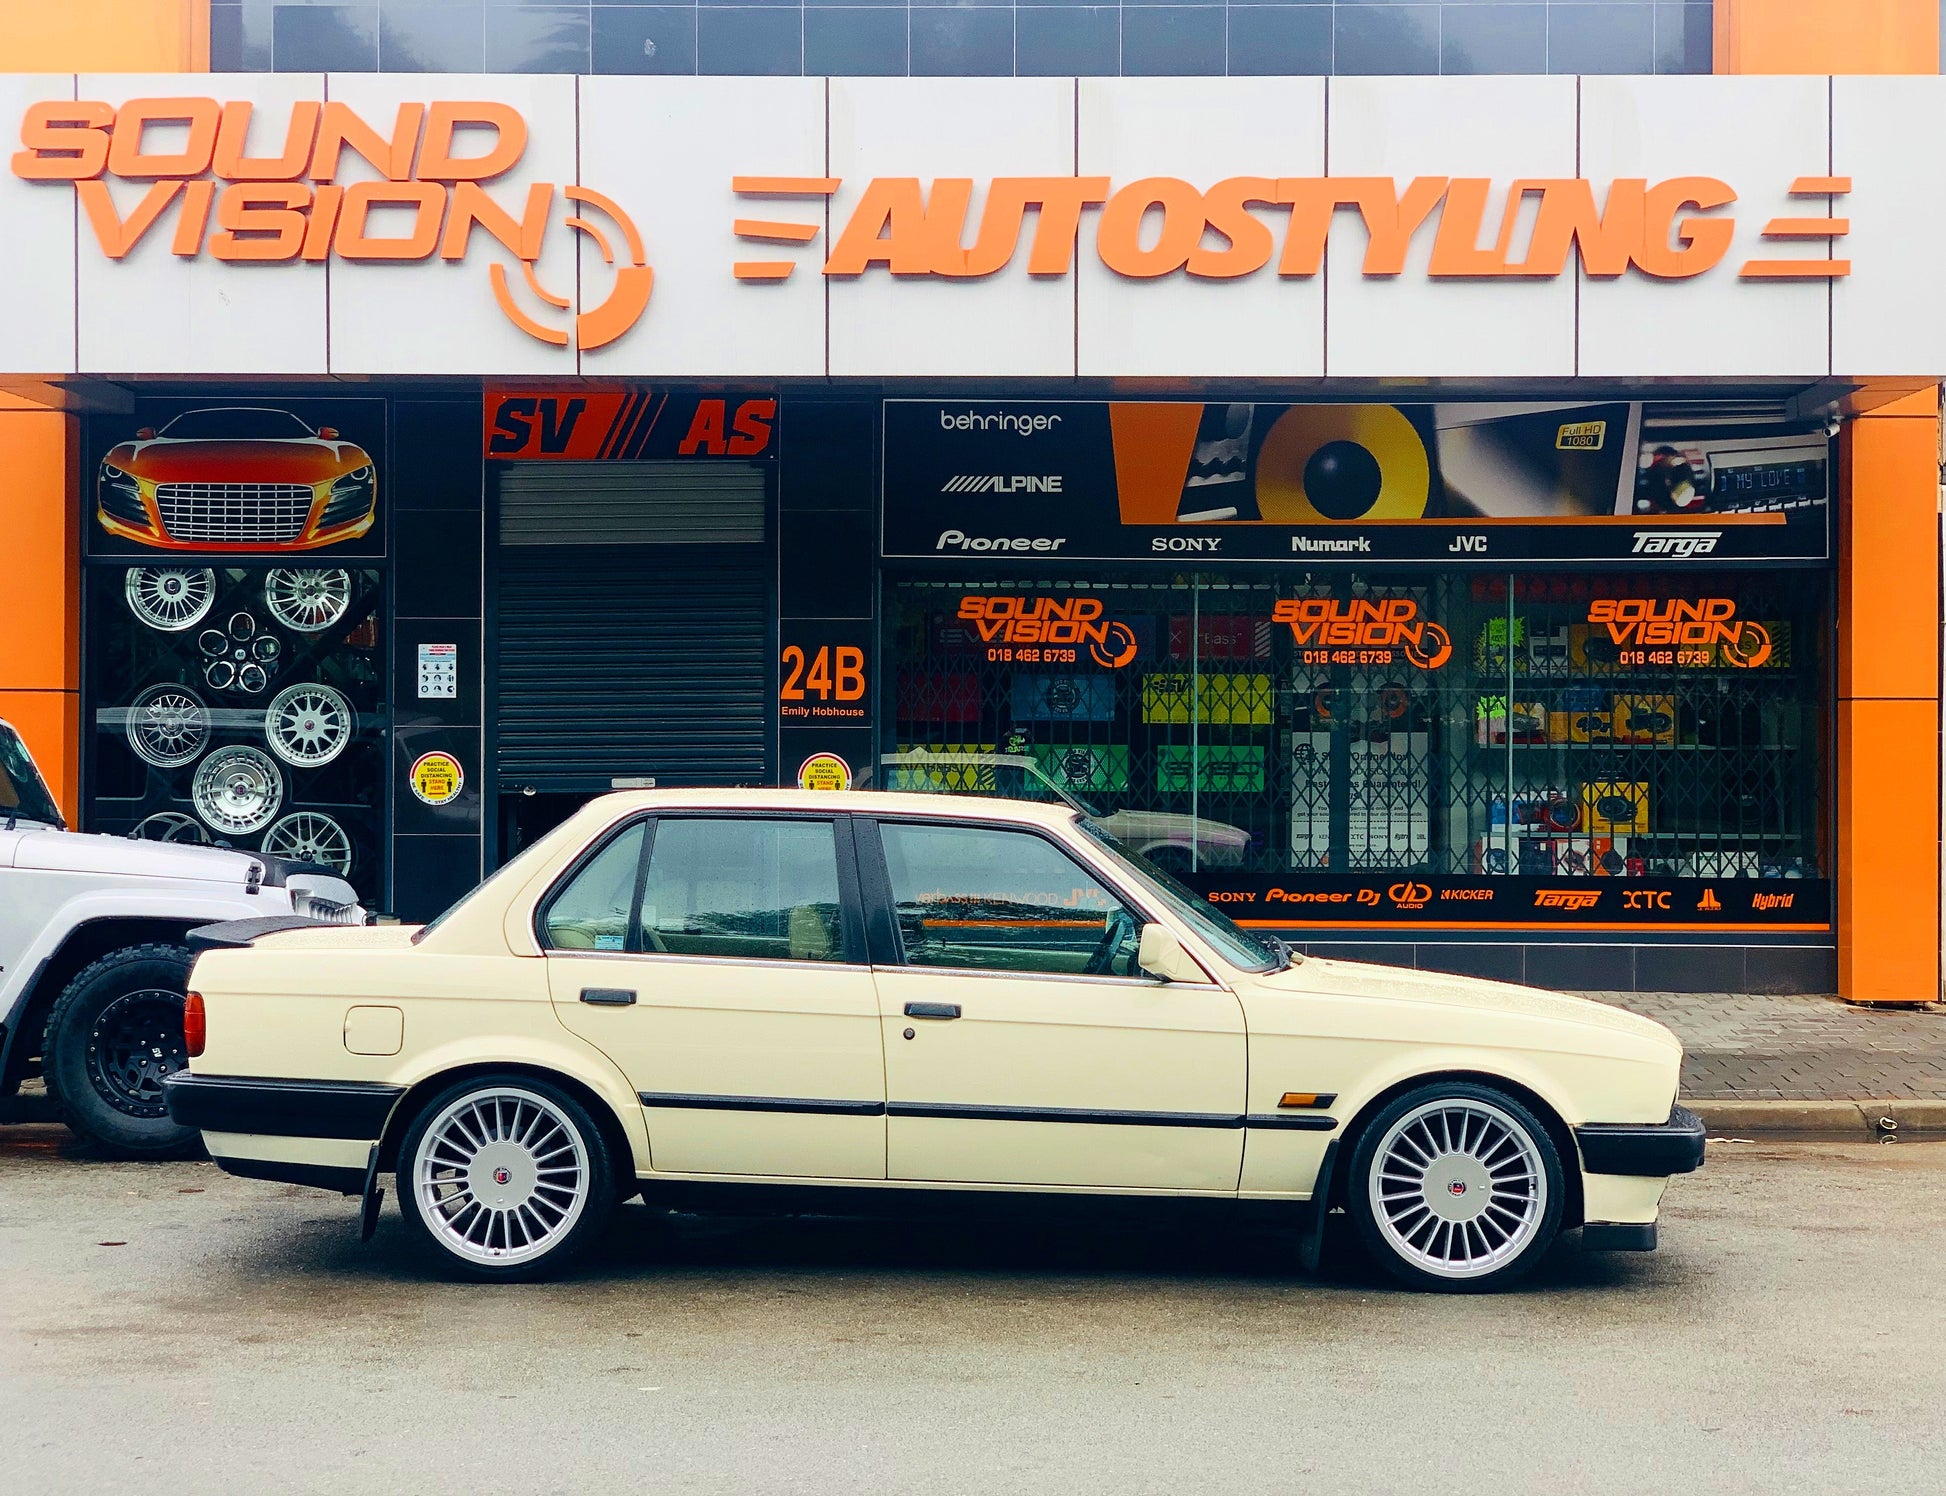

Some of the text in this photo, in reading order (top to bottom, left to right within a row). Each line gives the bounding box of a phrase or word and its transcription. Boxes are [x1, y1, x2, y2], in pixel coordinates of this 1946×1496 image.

[11, 97, 528, 181] SOUND
[74, 180, 555, 261] VISION
[822, 176, 1737, 279] AUTOSTYLING
[489, 398, 587, 454] SV
[678, 400, 778, 455] AS
[941, 410, 1062, 436] behringer
[1562, 424, 1602, 435] Full HD
[1567, 436, 1593, 446] 1080
[936, 530, 1066, 551] Pioneer
[1152, 538, 1222, 551] SONY
[1292, 536, 1371, 552] Numark
[1449, 536, 1487, 552] JVC
[1632, 532, 1723, 558] Targa
[957, 596, 1104, 621] SOUND
[1272, 599, 1417, 623] SOUND
[1587, 599, 1736, 622] SOUND
[976, 619, 1110, 644] VISION
[1290, 622, 1424, 645] VISION
[1606, 621, 1743, 645] VISION
[987, 648, 1076, 662] 018 462 6739
[1303, 650, 1329, 664] 018
[1331, 650, 1356, 664] 462
[1359, 650, 1392, 664] 6739
[1620, 651, 1710, 664] 018 462 6739
[781, 645, 866, 700] 24B
[781, 706, 865, 717] Emily Hobhouse
[1208, 892, 1256, 902] SONY
[1265, 888, 1352, 902] Pioneer
[1450, 889, 1494, 900] KICKER
[1534, 889, 1602, 910] Targa
[1752, 892, 1794, 911] Hybrid
